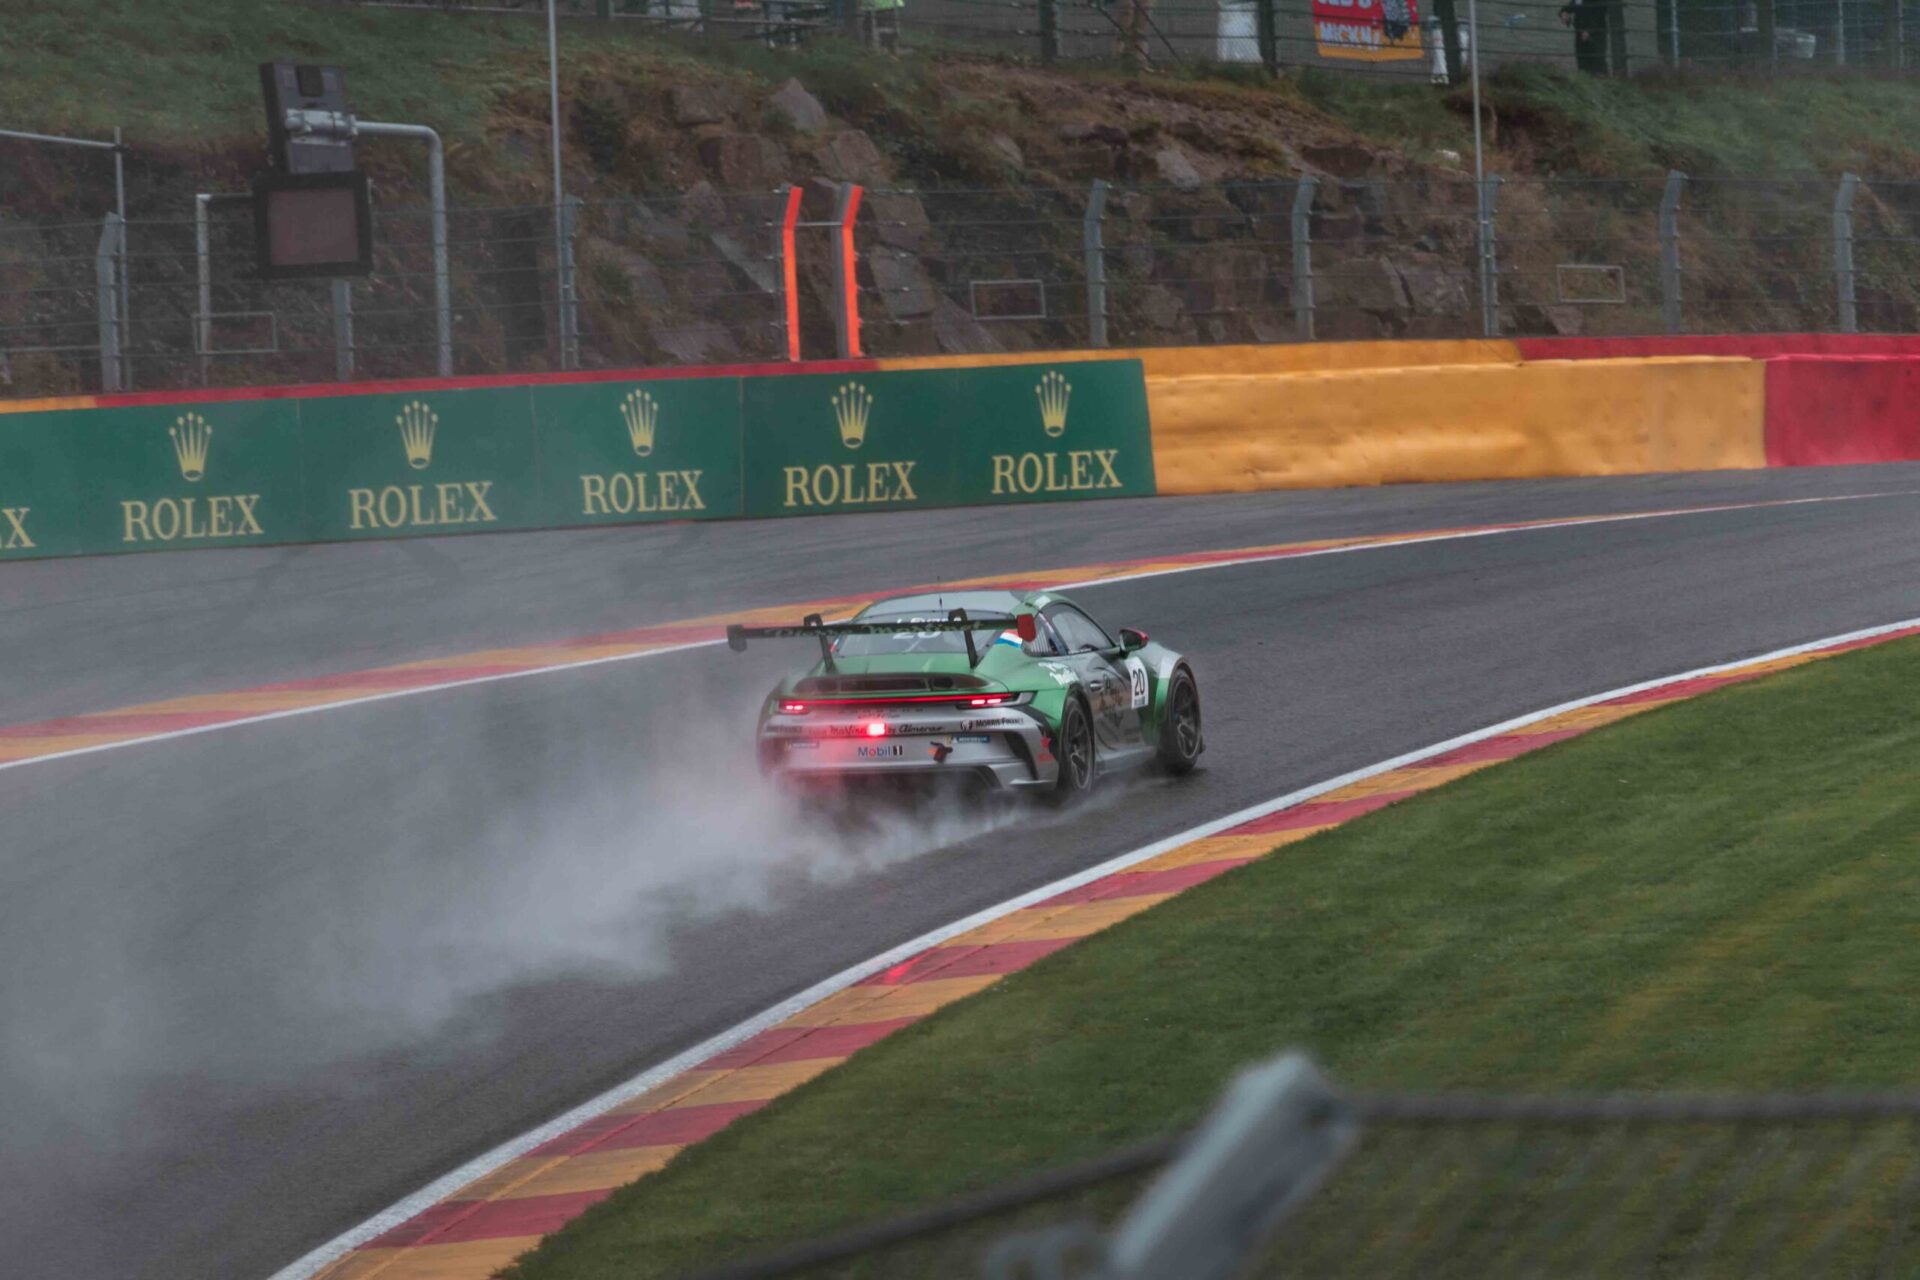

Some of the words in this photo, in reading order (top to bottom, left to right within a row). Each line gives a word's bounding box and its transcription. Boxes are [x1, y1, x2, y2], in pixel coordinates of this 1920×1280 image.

[581, 470, 705, 514] ROLEX
[783, 461, 917, 507] ROLEX
[992, 449, 1122, 494] ROLEX
[121, 495, 264, 541] ROLEX
[349, 481, 497, 529] ROLEX
[0, 508, 35, 548] X
[1132, 668, 1145, 696] 20
[857, 746, 890, 756] Mobil
